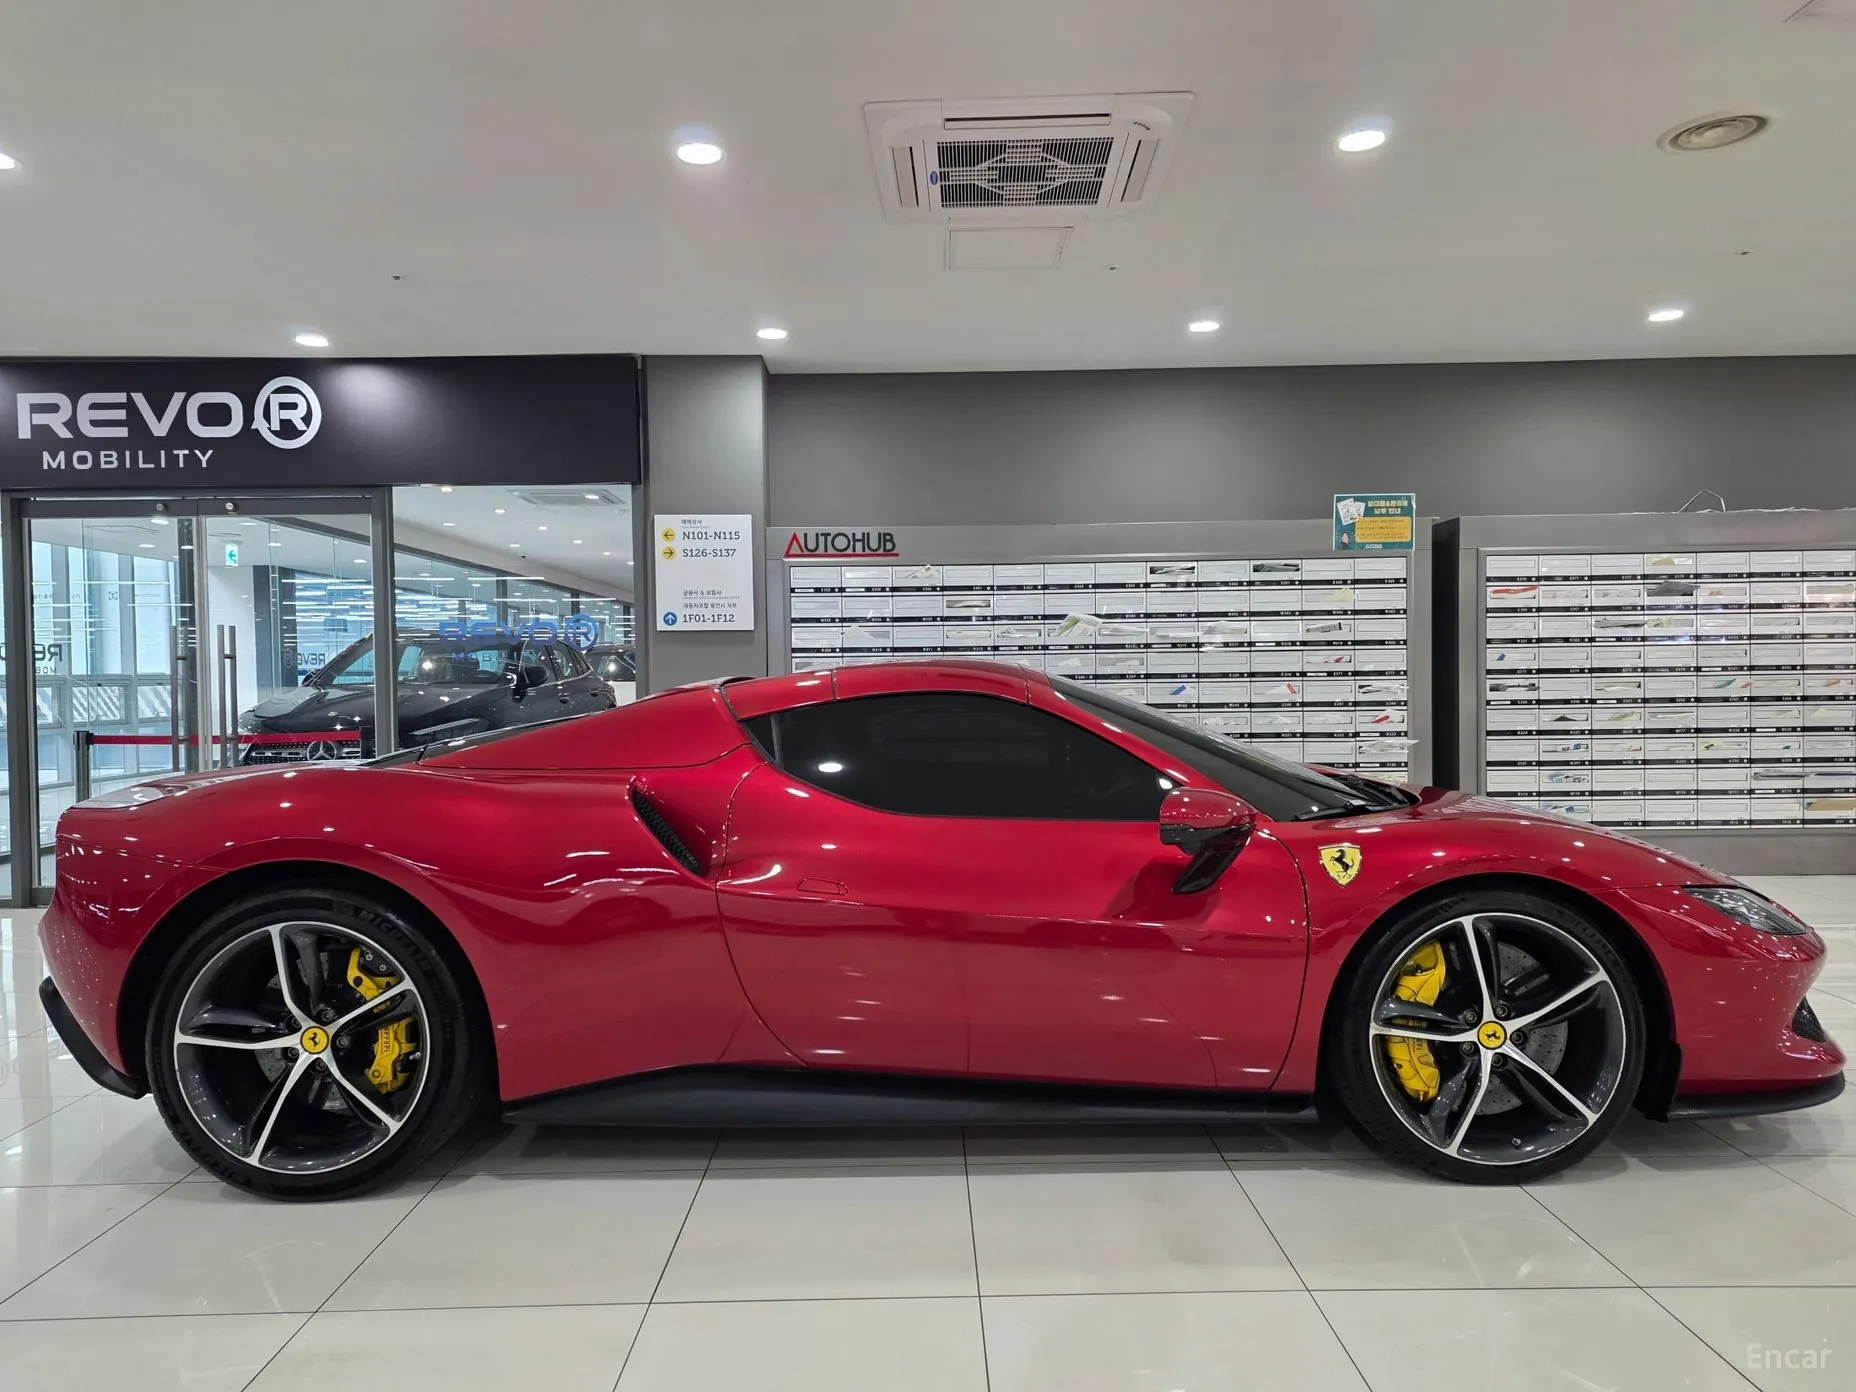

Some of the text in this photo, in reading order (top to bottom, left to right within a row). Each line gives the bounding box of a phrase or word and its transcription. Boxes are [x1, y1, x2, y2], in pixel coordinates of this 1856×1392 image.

[16, 391, 244, 439] REVO
[42, 449, 214, 470] MOBILITY
[682, 531, 741, 540] N101-N115
[784, 531, 899, 558] AUTOHUB
[682, 548, 737, 558] S126-S137
[682, 613, 735, 623] 1F01-1F12
[438, 621, 558, 645] REVO
